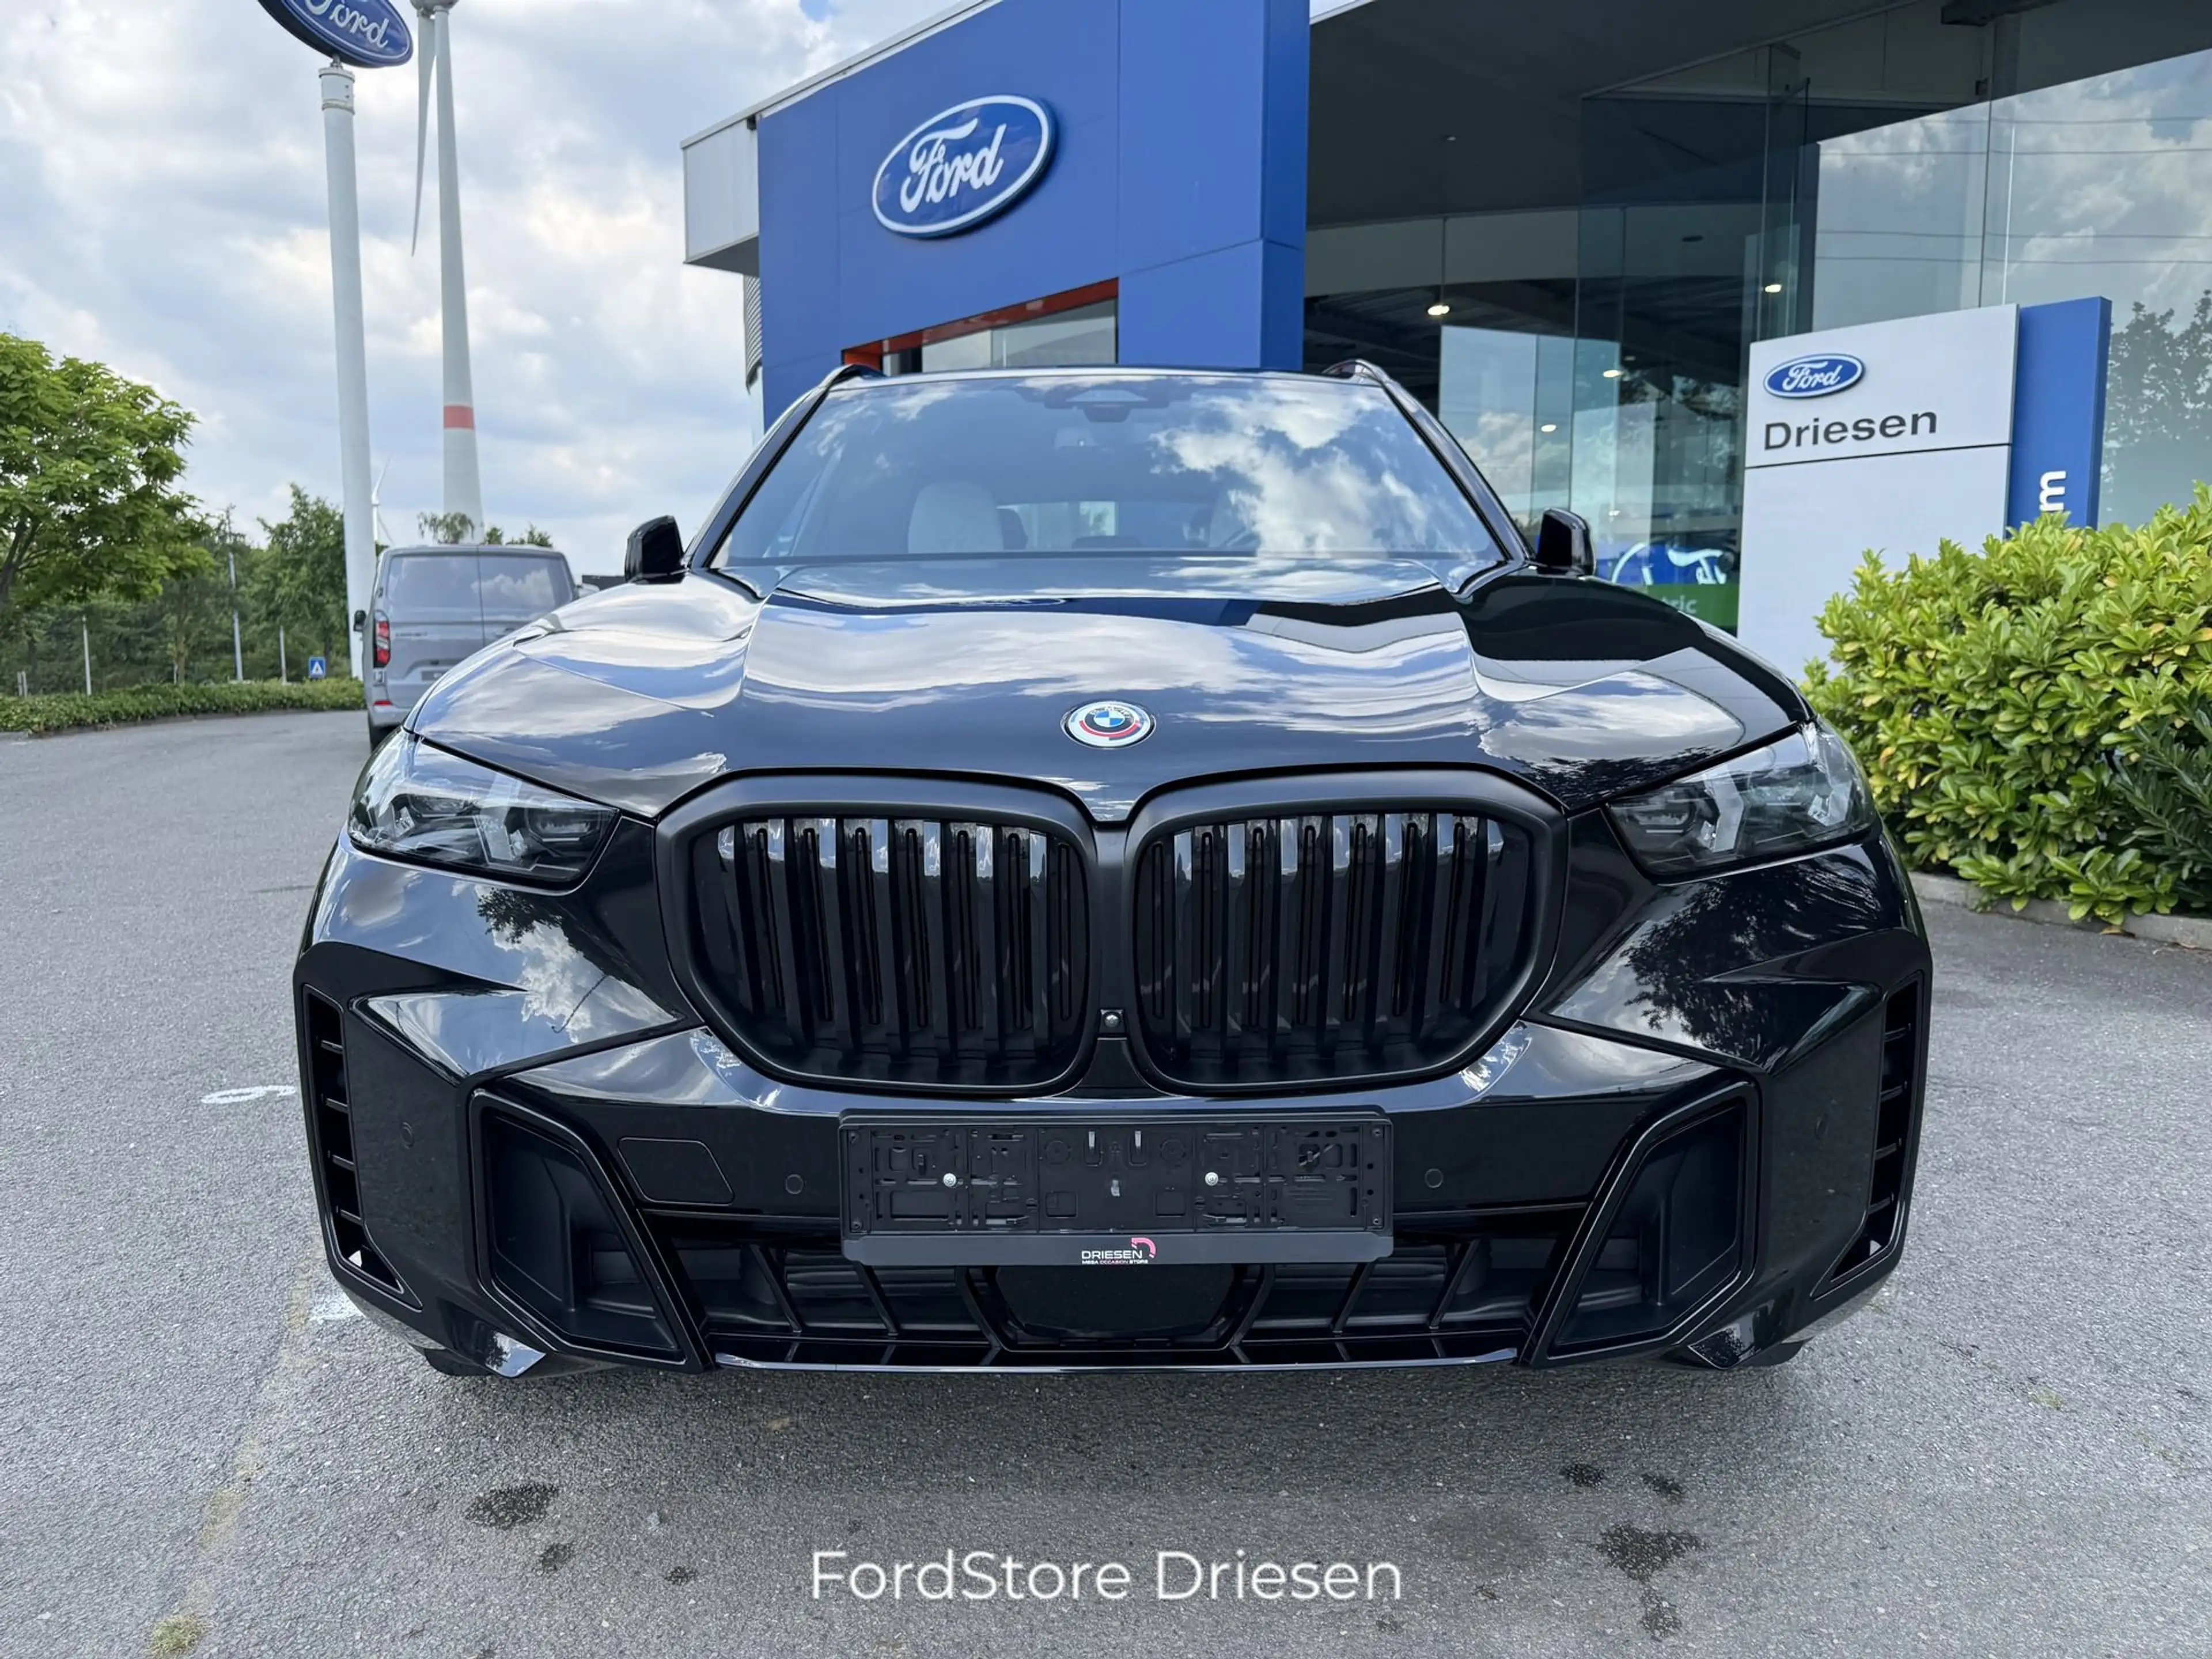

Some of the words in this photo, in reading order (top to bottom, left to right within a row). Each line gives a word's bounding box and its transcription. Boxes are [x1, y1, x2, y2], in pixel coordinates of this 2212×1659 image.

[900, 118, 1006, 213] Ford
[1782, 361, 1842, 391] Ford
[1764, 411, 1937, 450] Driesen
[1081, 1249, 1143, 1259] DRIESEN
